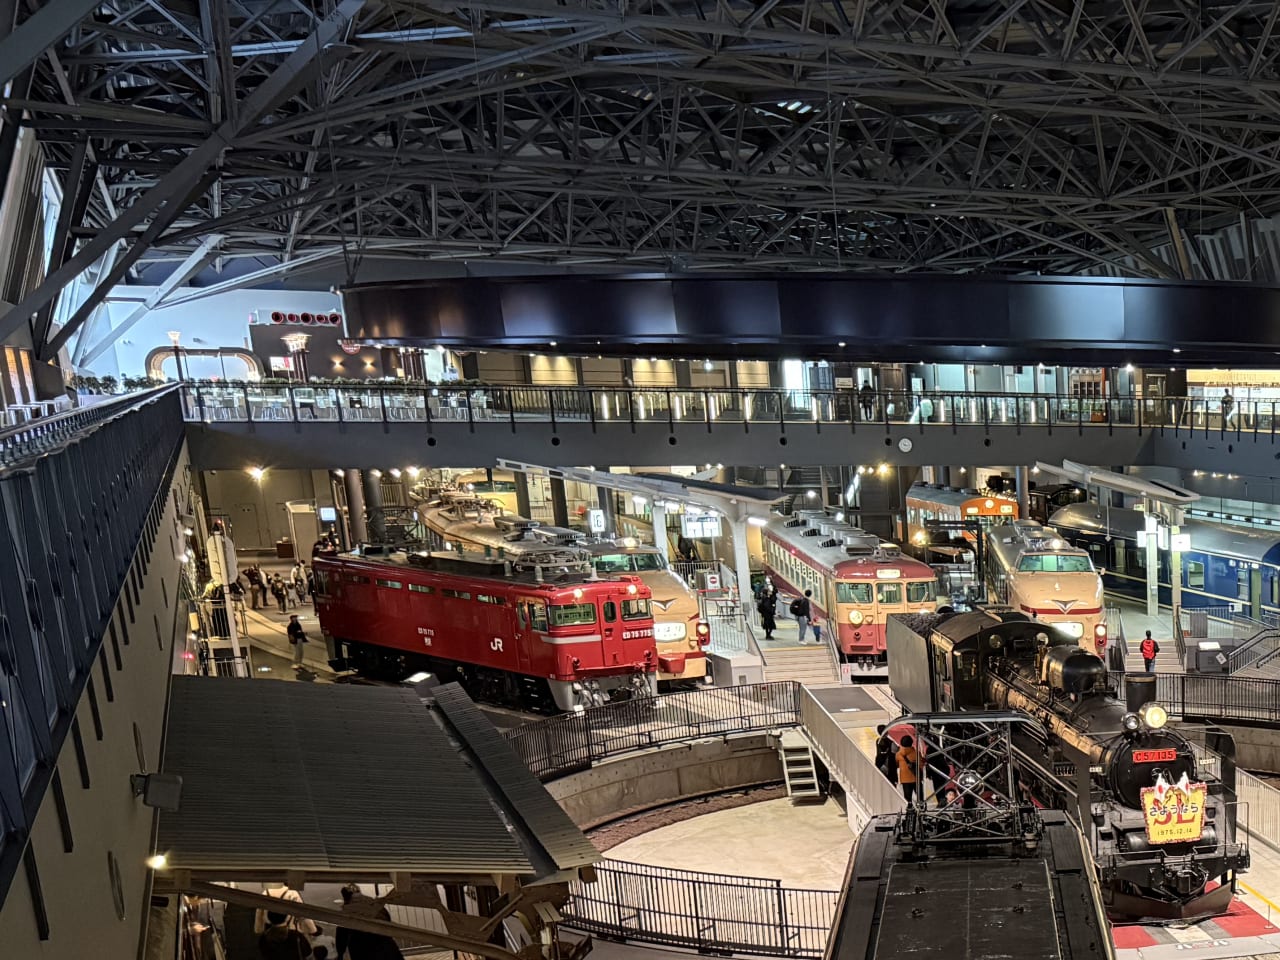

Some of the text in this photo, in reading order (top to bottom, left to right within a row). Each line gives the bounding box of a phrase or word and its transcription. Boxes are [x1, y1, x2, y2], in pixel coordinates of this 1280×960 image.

[490, 637, 503, 652] JR
[1149, 802, 1199, 817] さようなら
